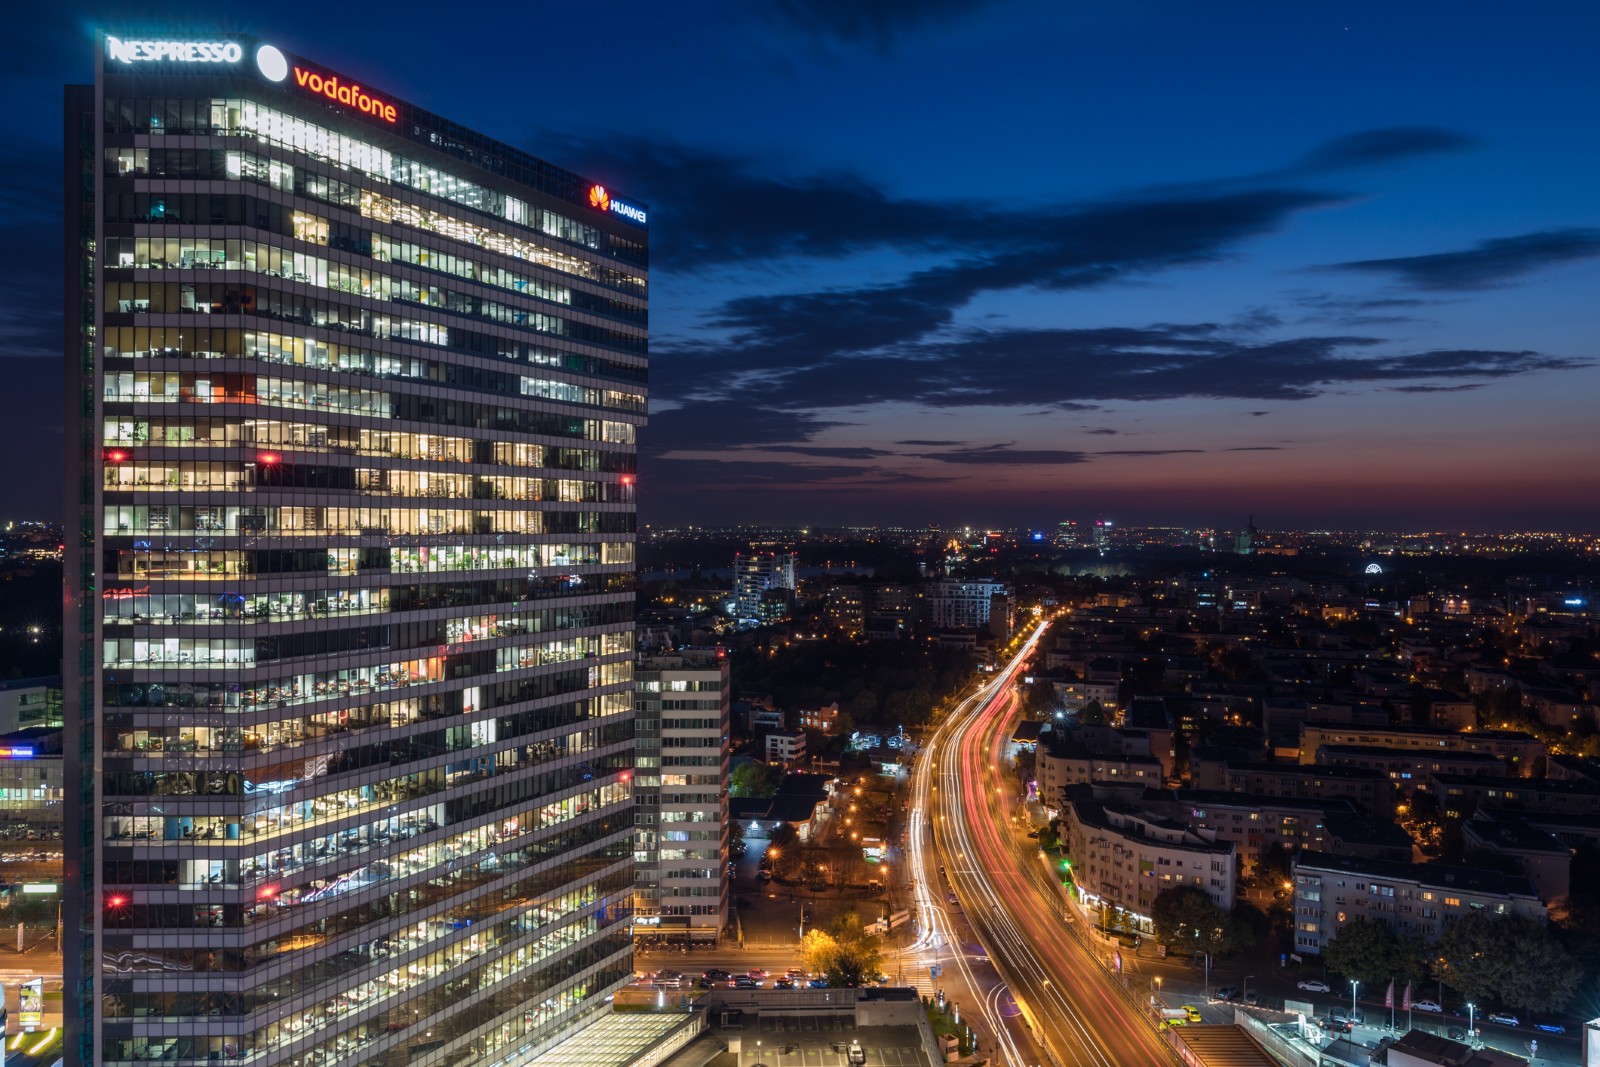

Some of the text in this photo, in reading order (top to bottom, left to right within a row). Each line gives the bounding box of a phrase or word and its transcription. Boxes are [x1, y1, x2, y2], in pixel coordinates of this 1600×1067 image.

[107, 37, 242, 64] NESPRESSO
[294, 67, 397, 122] vodafone
[610, 200, 646, 222] HUAWEI
